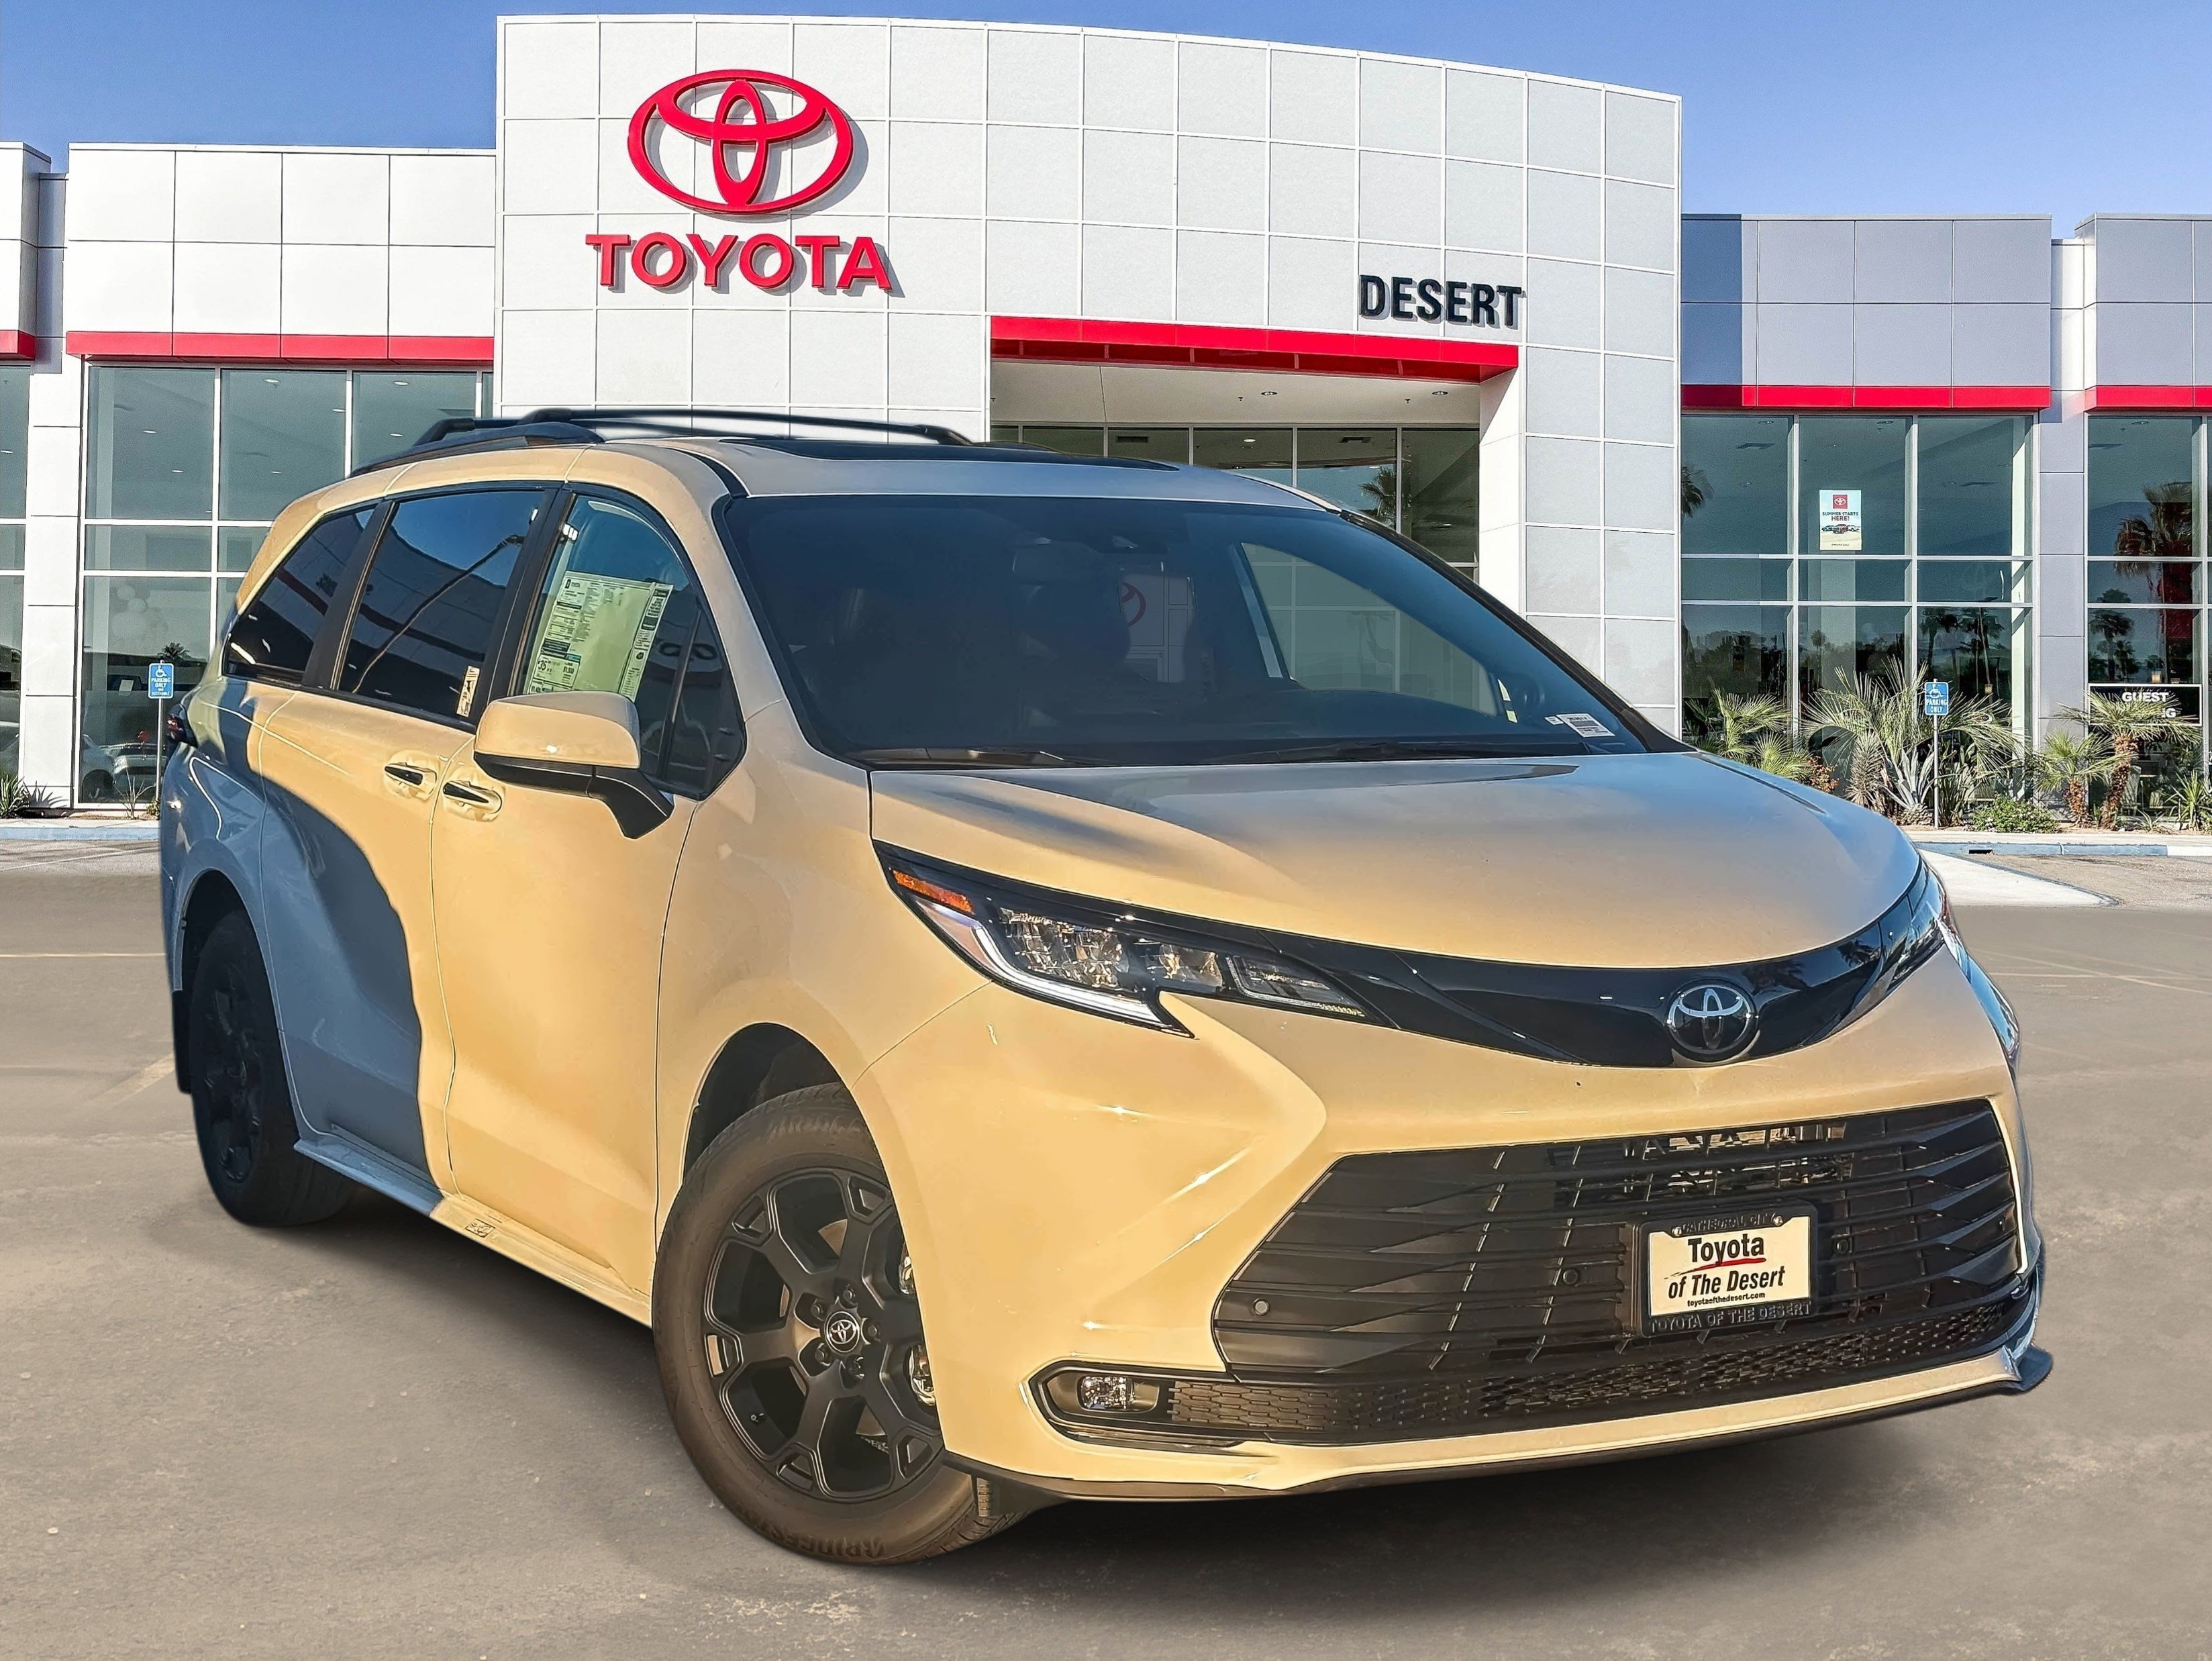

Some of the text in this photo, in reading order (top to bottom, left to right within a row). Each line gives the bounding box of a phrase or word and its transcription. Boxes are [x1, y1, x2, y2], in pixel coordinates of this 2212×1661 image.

[585, 232, 893, 292] TOYOTA
[1358, 274, 1523, 327] DESERT
[2122, 692, 2169, 702] GUEST
[1688, 1234, 1764, 1266] Toyota
[1668, 1266, 1785, 1299] of The Desert
[1687, 1292, 1766, 1307] toyotaofthedesert.com
[1649, 1301, 1811, 1332] TOYOTA OF THE DESERT
